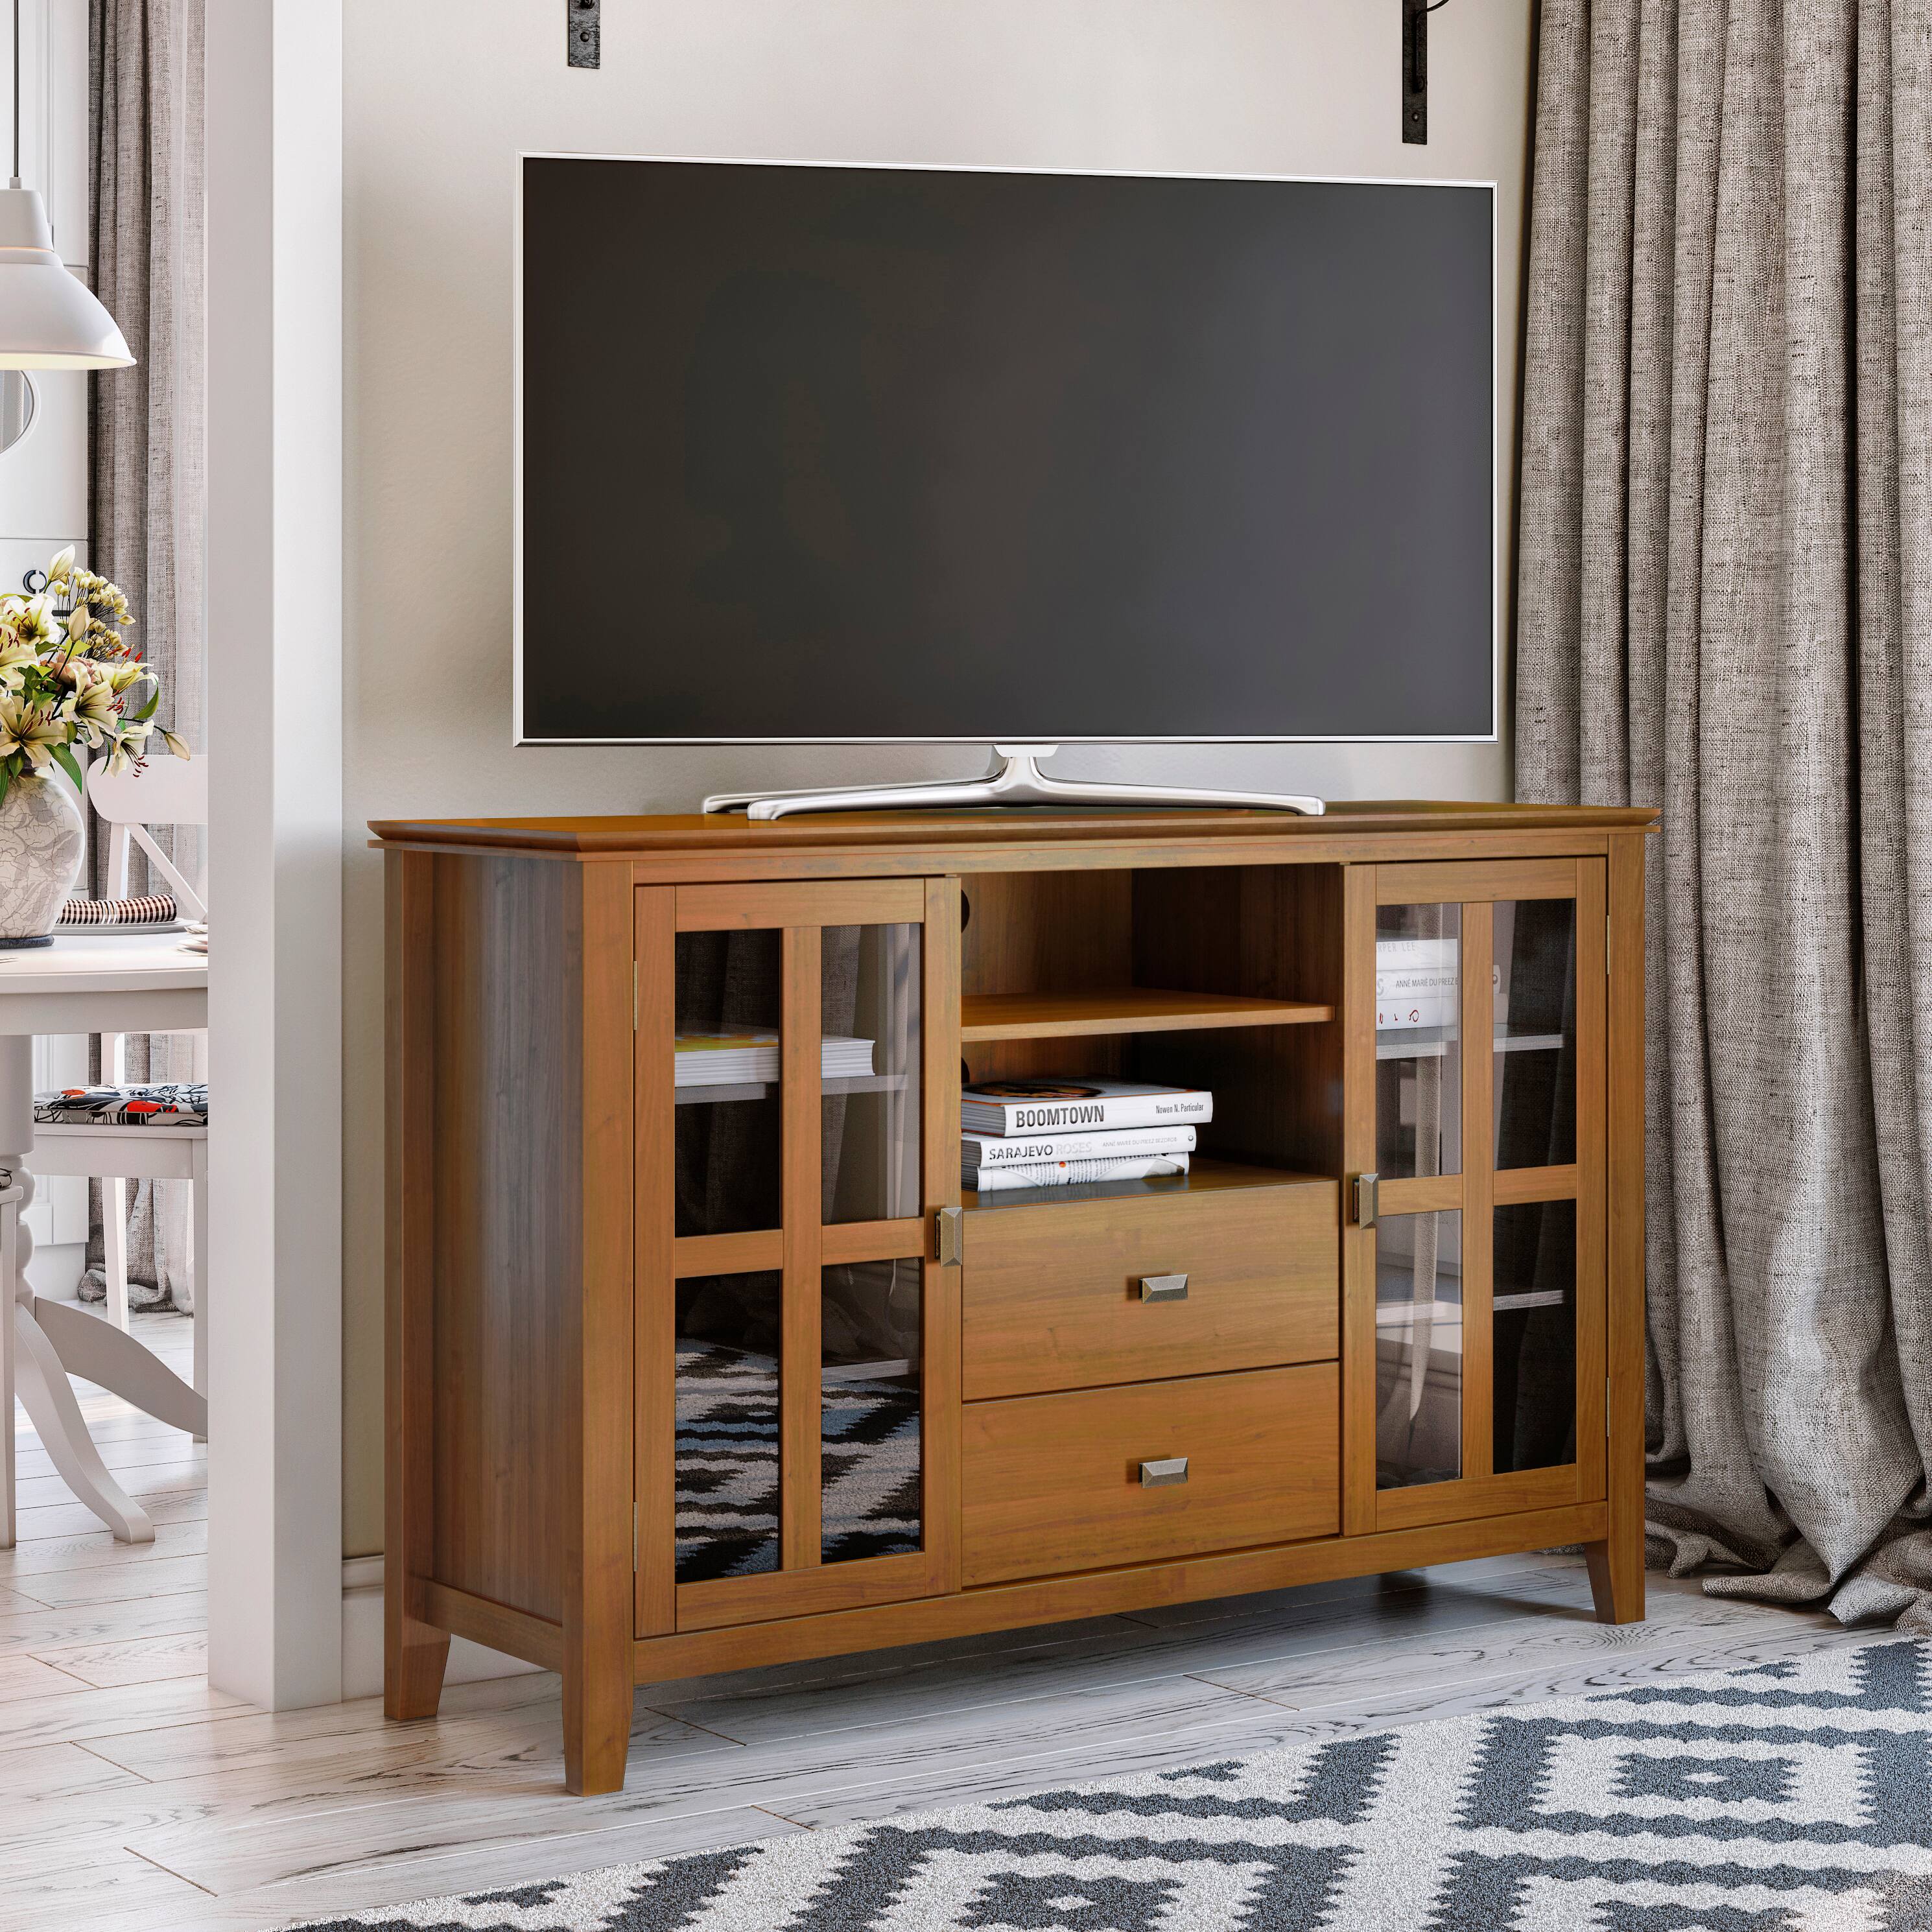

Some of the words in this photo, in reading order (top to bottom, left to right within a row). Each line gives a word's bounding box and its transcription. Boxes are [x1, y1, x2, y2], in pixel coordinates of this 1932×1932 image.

[1377, 942, 1397, 953] RPER
[1438, 977, 1455, 985] PREEZ
[1016, 1105, 1105, 1128] BOOMTOWN
[1156, 1105, 1173, 1114] Nowen
[1174, 1103, 1180, 1113] N.
[1181, 1102, 1204, 1113] Particular
[989, 1144, 1053, 1160] SARAJEVO
[1055, 1141, 1092, 1155] ROSES
